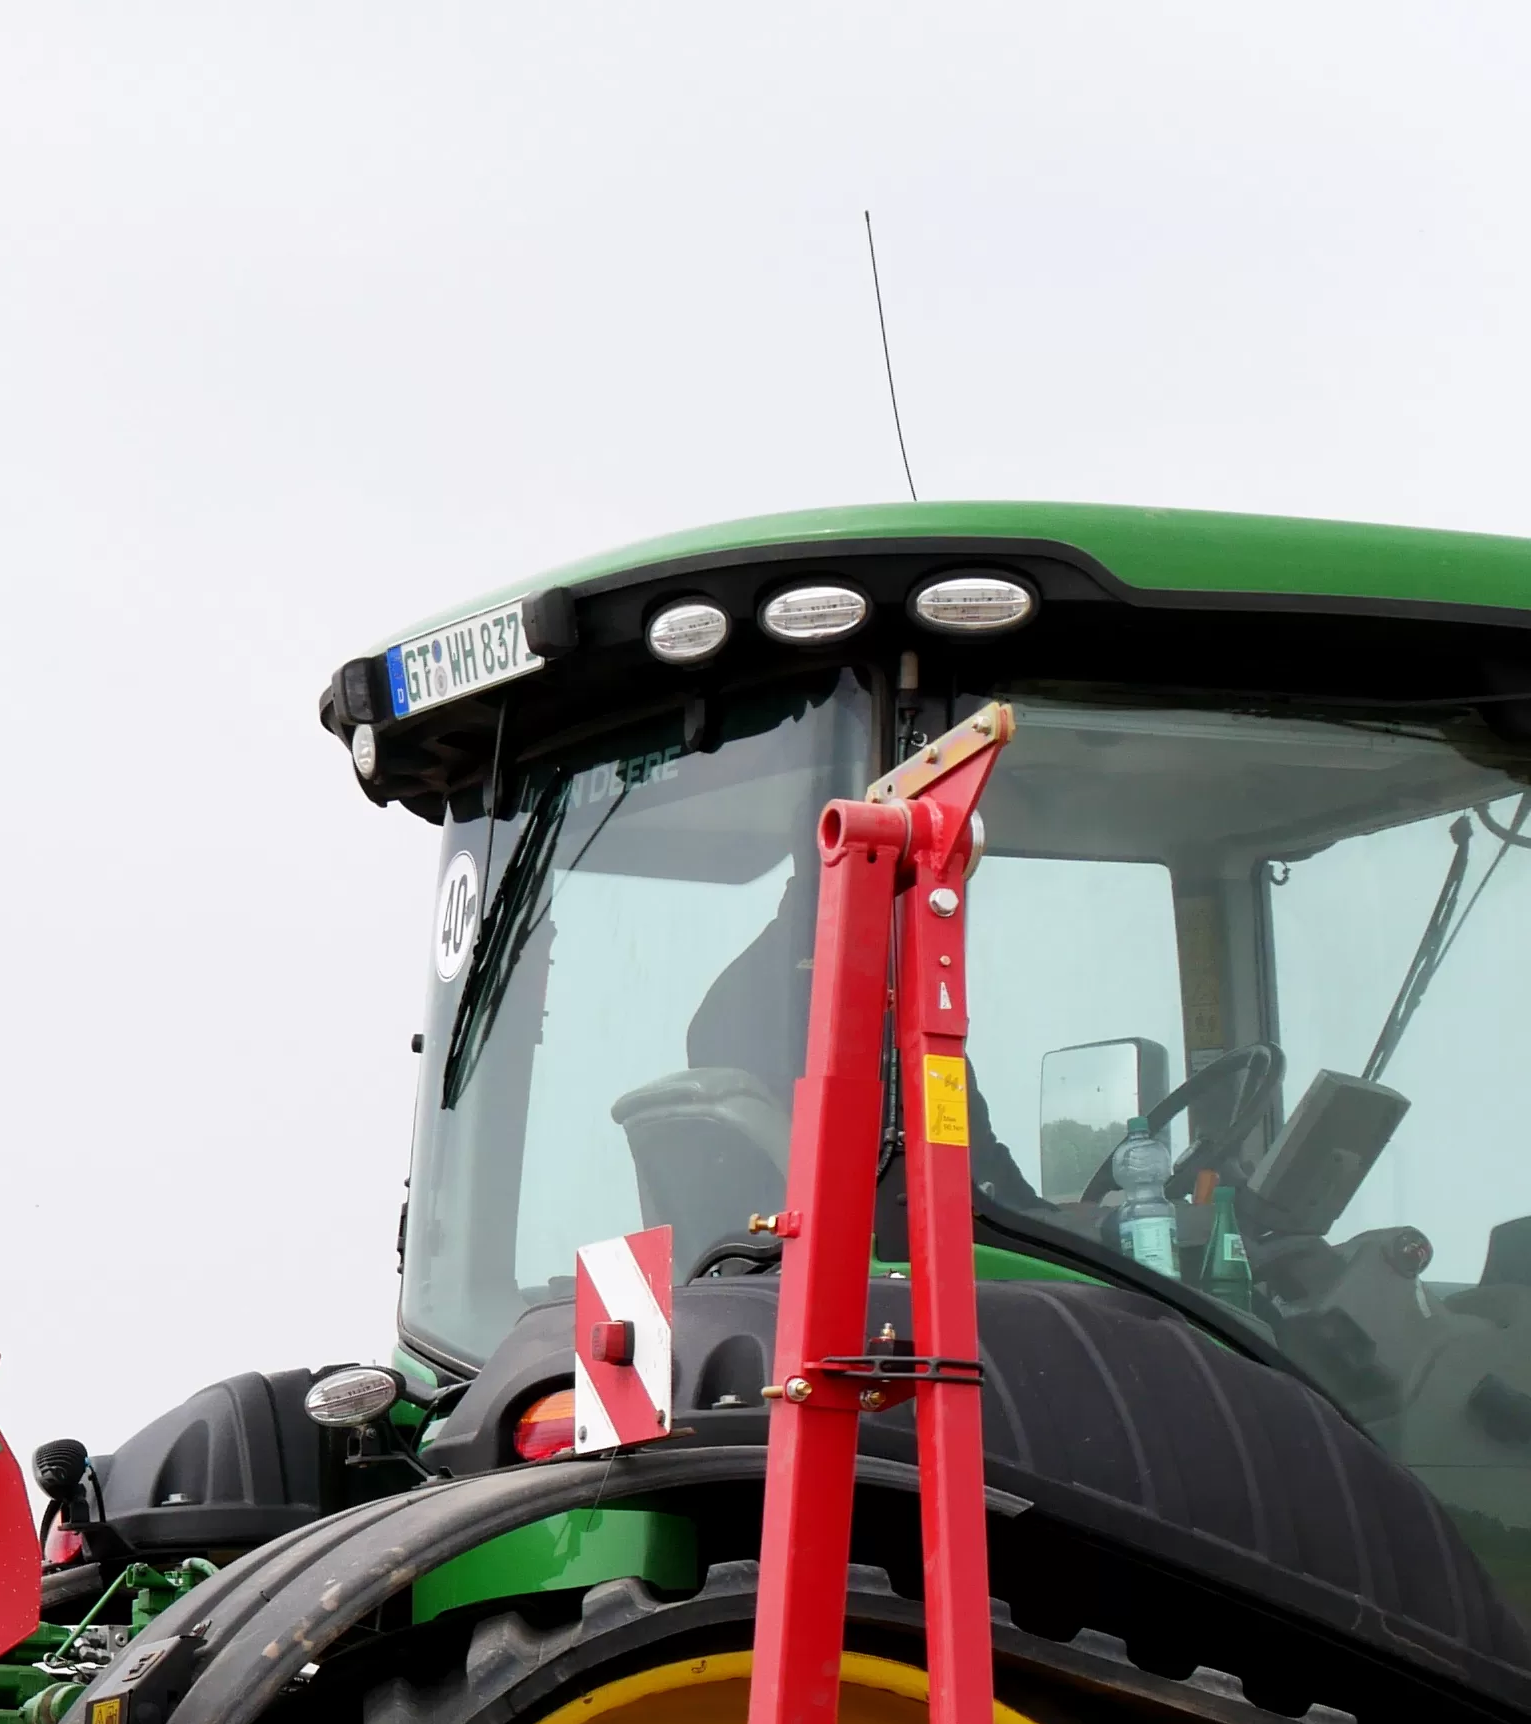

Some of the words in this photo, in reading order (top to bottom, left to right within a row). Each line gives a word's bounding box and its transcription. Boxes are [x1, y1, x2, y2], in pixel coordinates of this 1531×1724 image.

[404, 645, 431, 702] GT
[446, 628, 478, 686] WH
[481, 612, 538, 675] 837
[442, 874, 468, 957] 40
